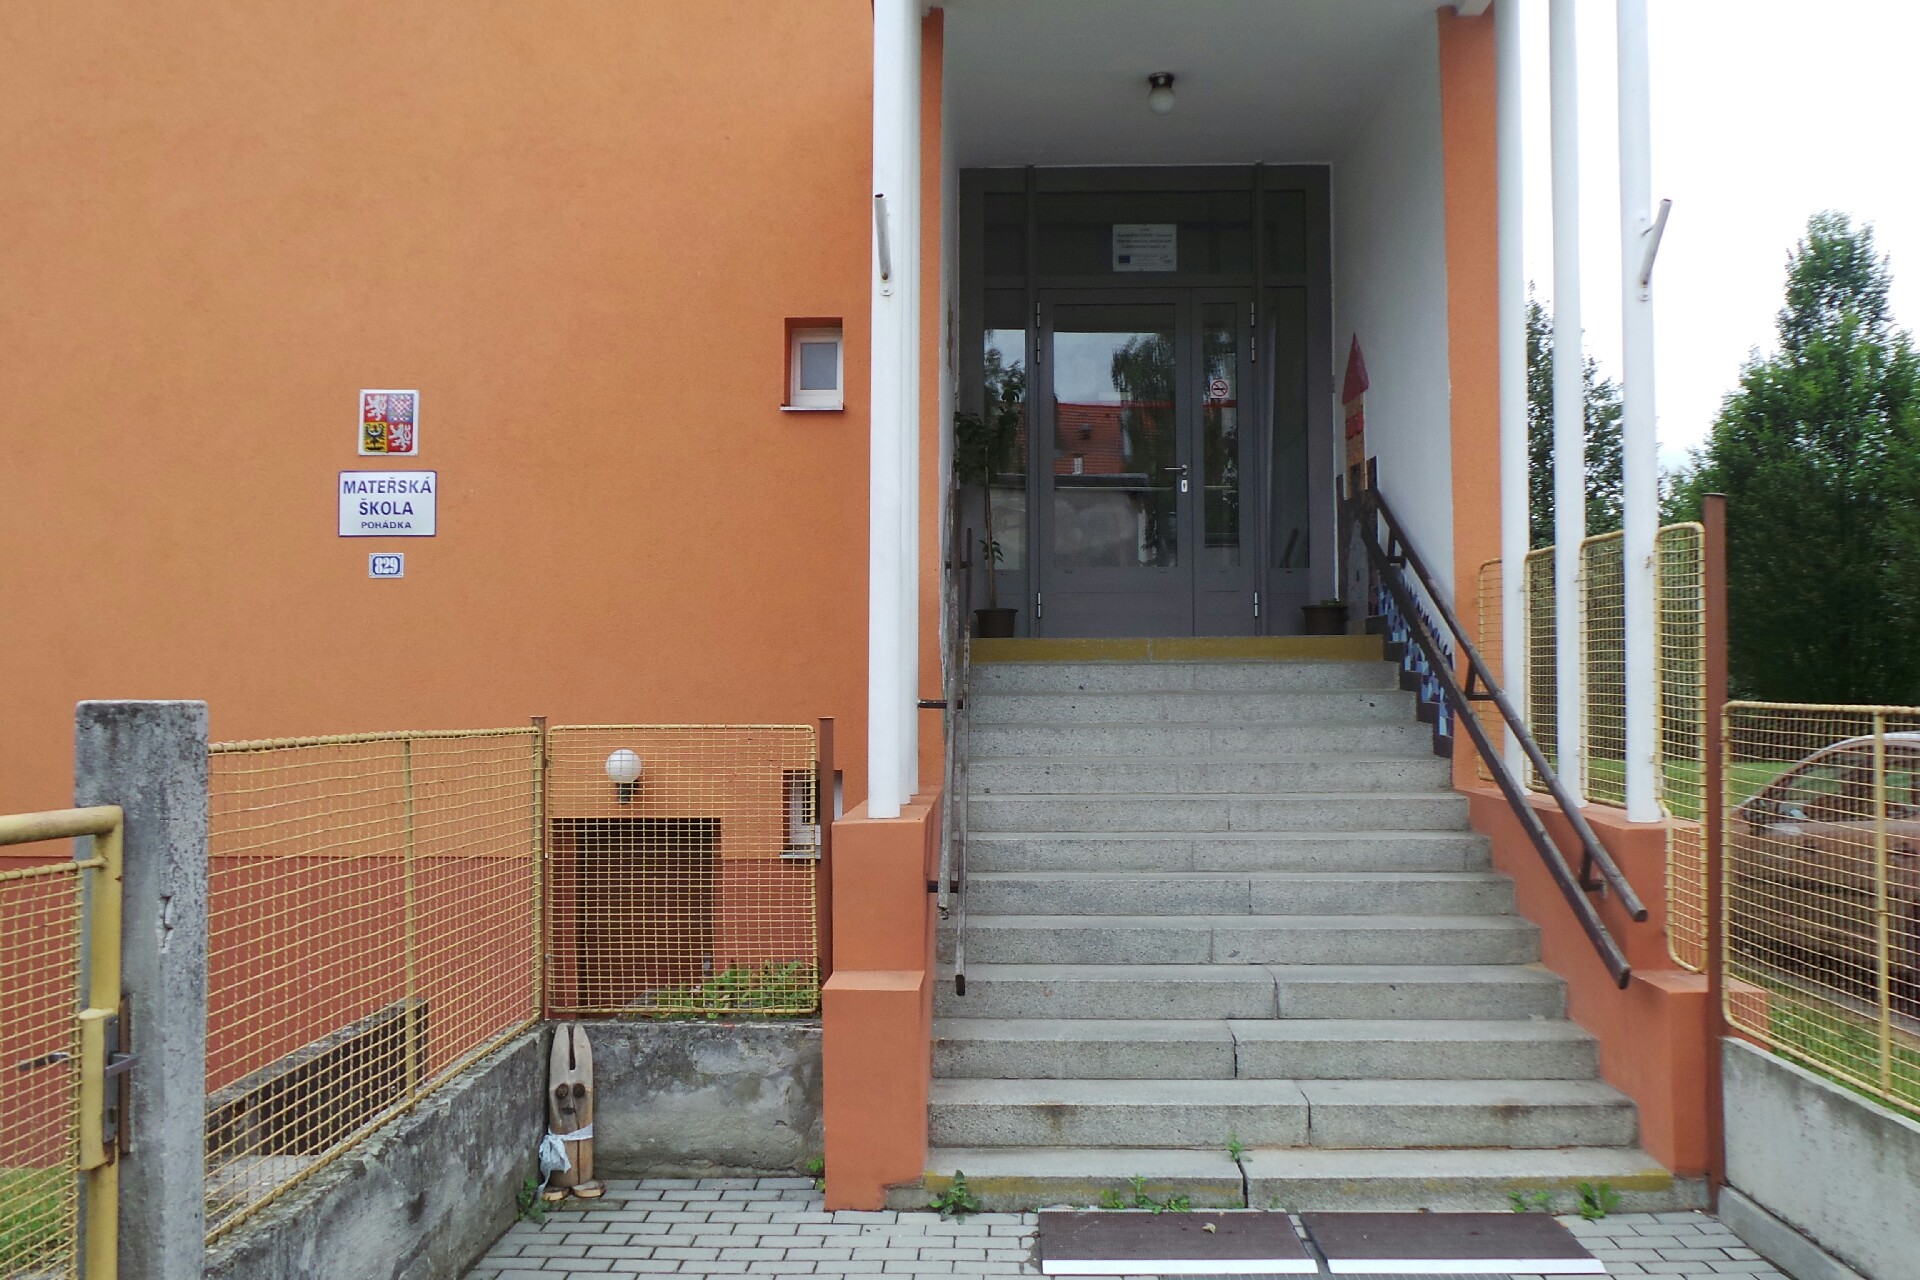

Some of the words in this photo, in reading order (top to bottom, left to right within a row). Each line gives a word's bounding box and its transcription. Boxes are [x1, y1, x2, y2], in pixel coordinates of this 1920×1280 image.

[343, 476, 432, 494] MATEŘSKÁ
[359, 498, 414, 515] ŠKOLA
[361, 520, 412, 529] POHÁDKA
[374, 557, 399, 574] 829
